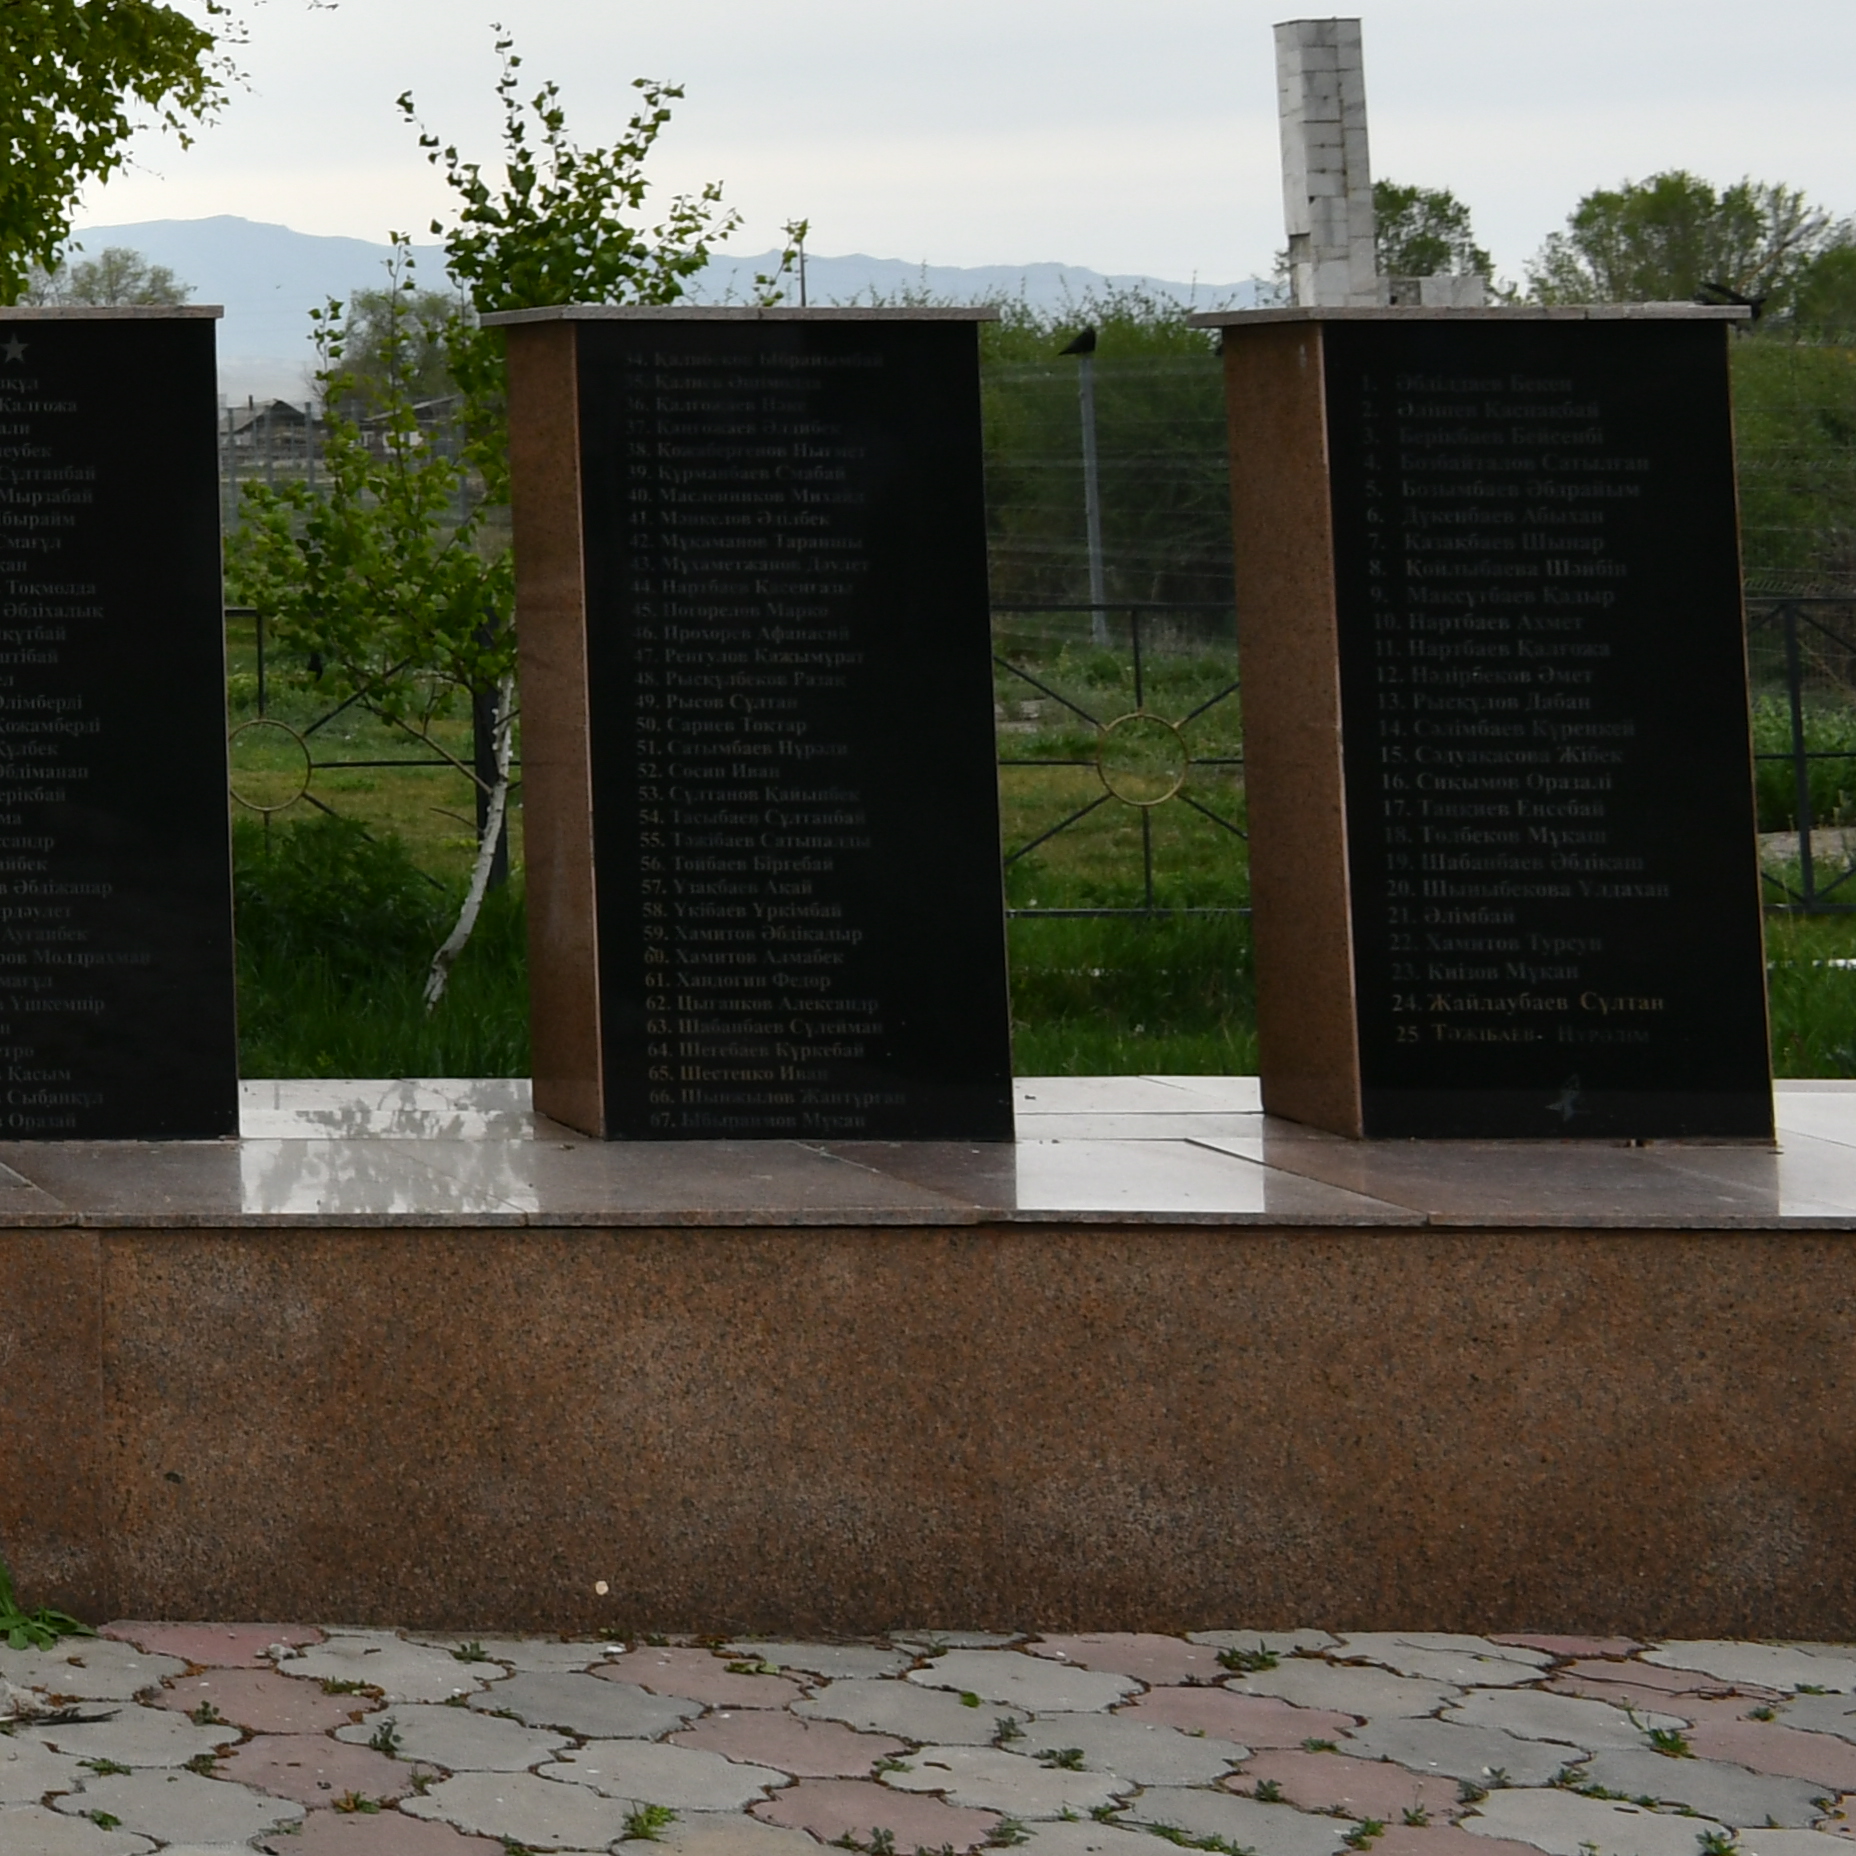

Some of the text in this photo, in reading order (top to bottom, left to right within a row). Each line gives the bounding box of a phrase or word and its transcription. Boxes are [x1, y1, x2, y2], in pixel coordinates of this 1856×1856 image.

[1364, 426, 1380, 444] 3.
[632, 602, 657, 617] 45.
[1374, 613, 1401, 630] 10.
[632, 626, 657, 640] 46.
[1377, 666, 1404, 683] 12.
[638, 762, 662, 778] 52.
[1388, 906, 1416, 924] 21.
[1389, 933, 1418, 951] 22.
[645, 972, 670, 987] 61.
[646, 995, 671, 1010] 62.
[1392, 994, 1422, 1012] 24.
[648, 1065, 674, 1081] 65.
